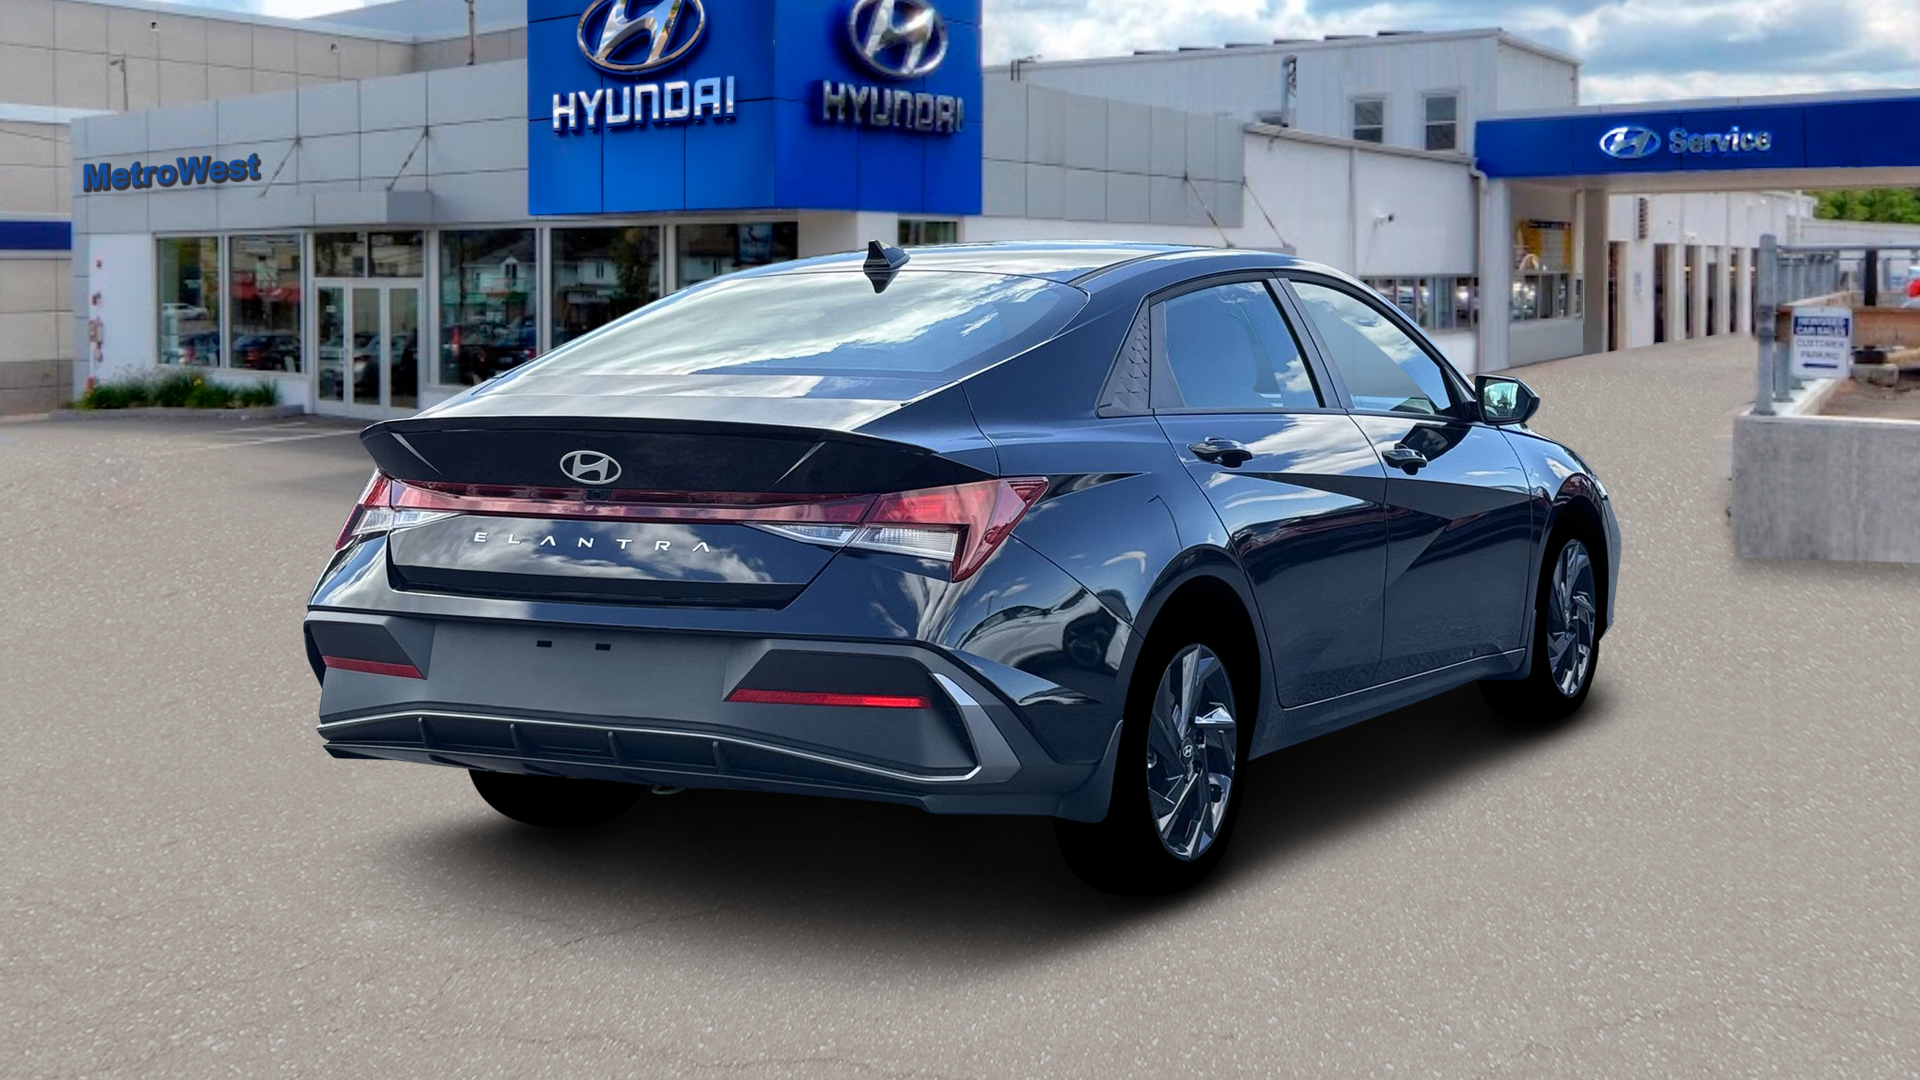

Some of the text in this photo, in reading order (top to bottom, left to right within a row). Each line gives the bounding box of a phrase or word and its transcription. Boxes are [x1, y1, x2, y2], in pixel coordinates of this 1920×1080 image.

[553, 76, 735, 130] HYUNDAI
[823, 80, 964, 133] HYUNDAI
[1669, 125, 1772, 153] Service
[83, 153, 262, 193] MetroWest
[1796, 326, 1816, 335] CAR
[1796, 338, 1844, 348] CUSTOMER
[1800, 350, 1839, 360] PARKING
[473, 531, 711, 553] ELANTRA
